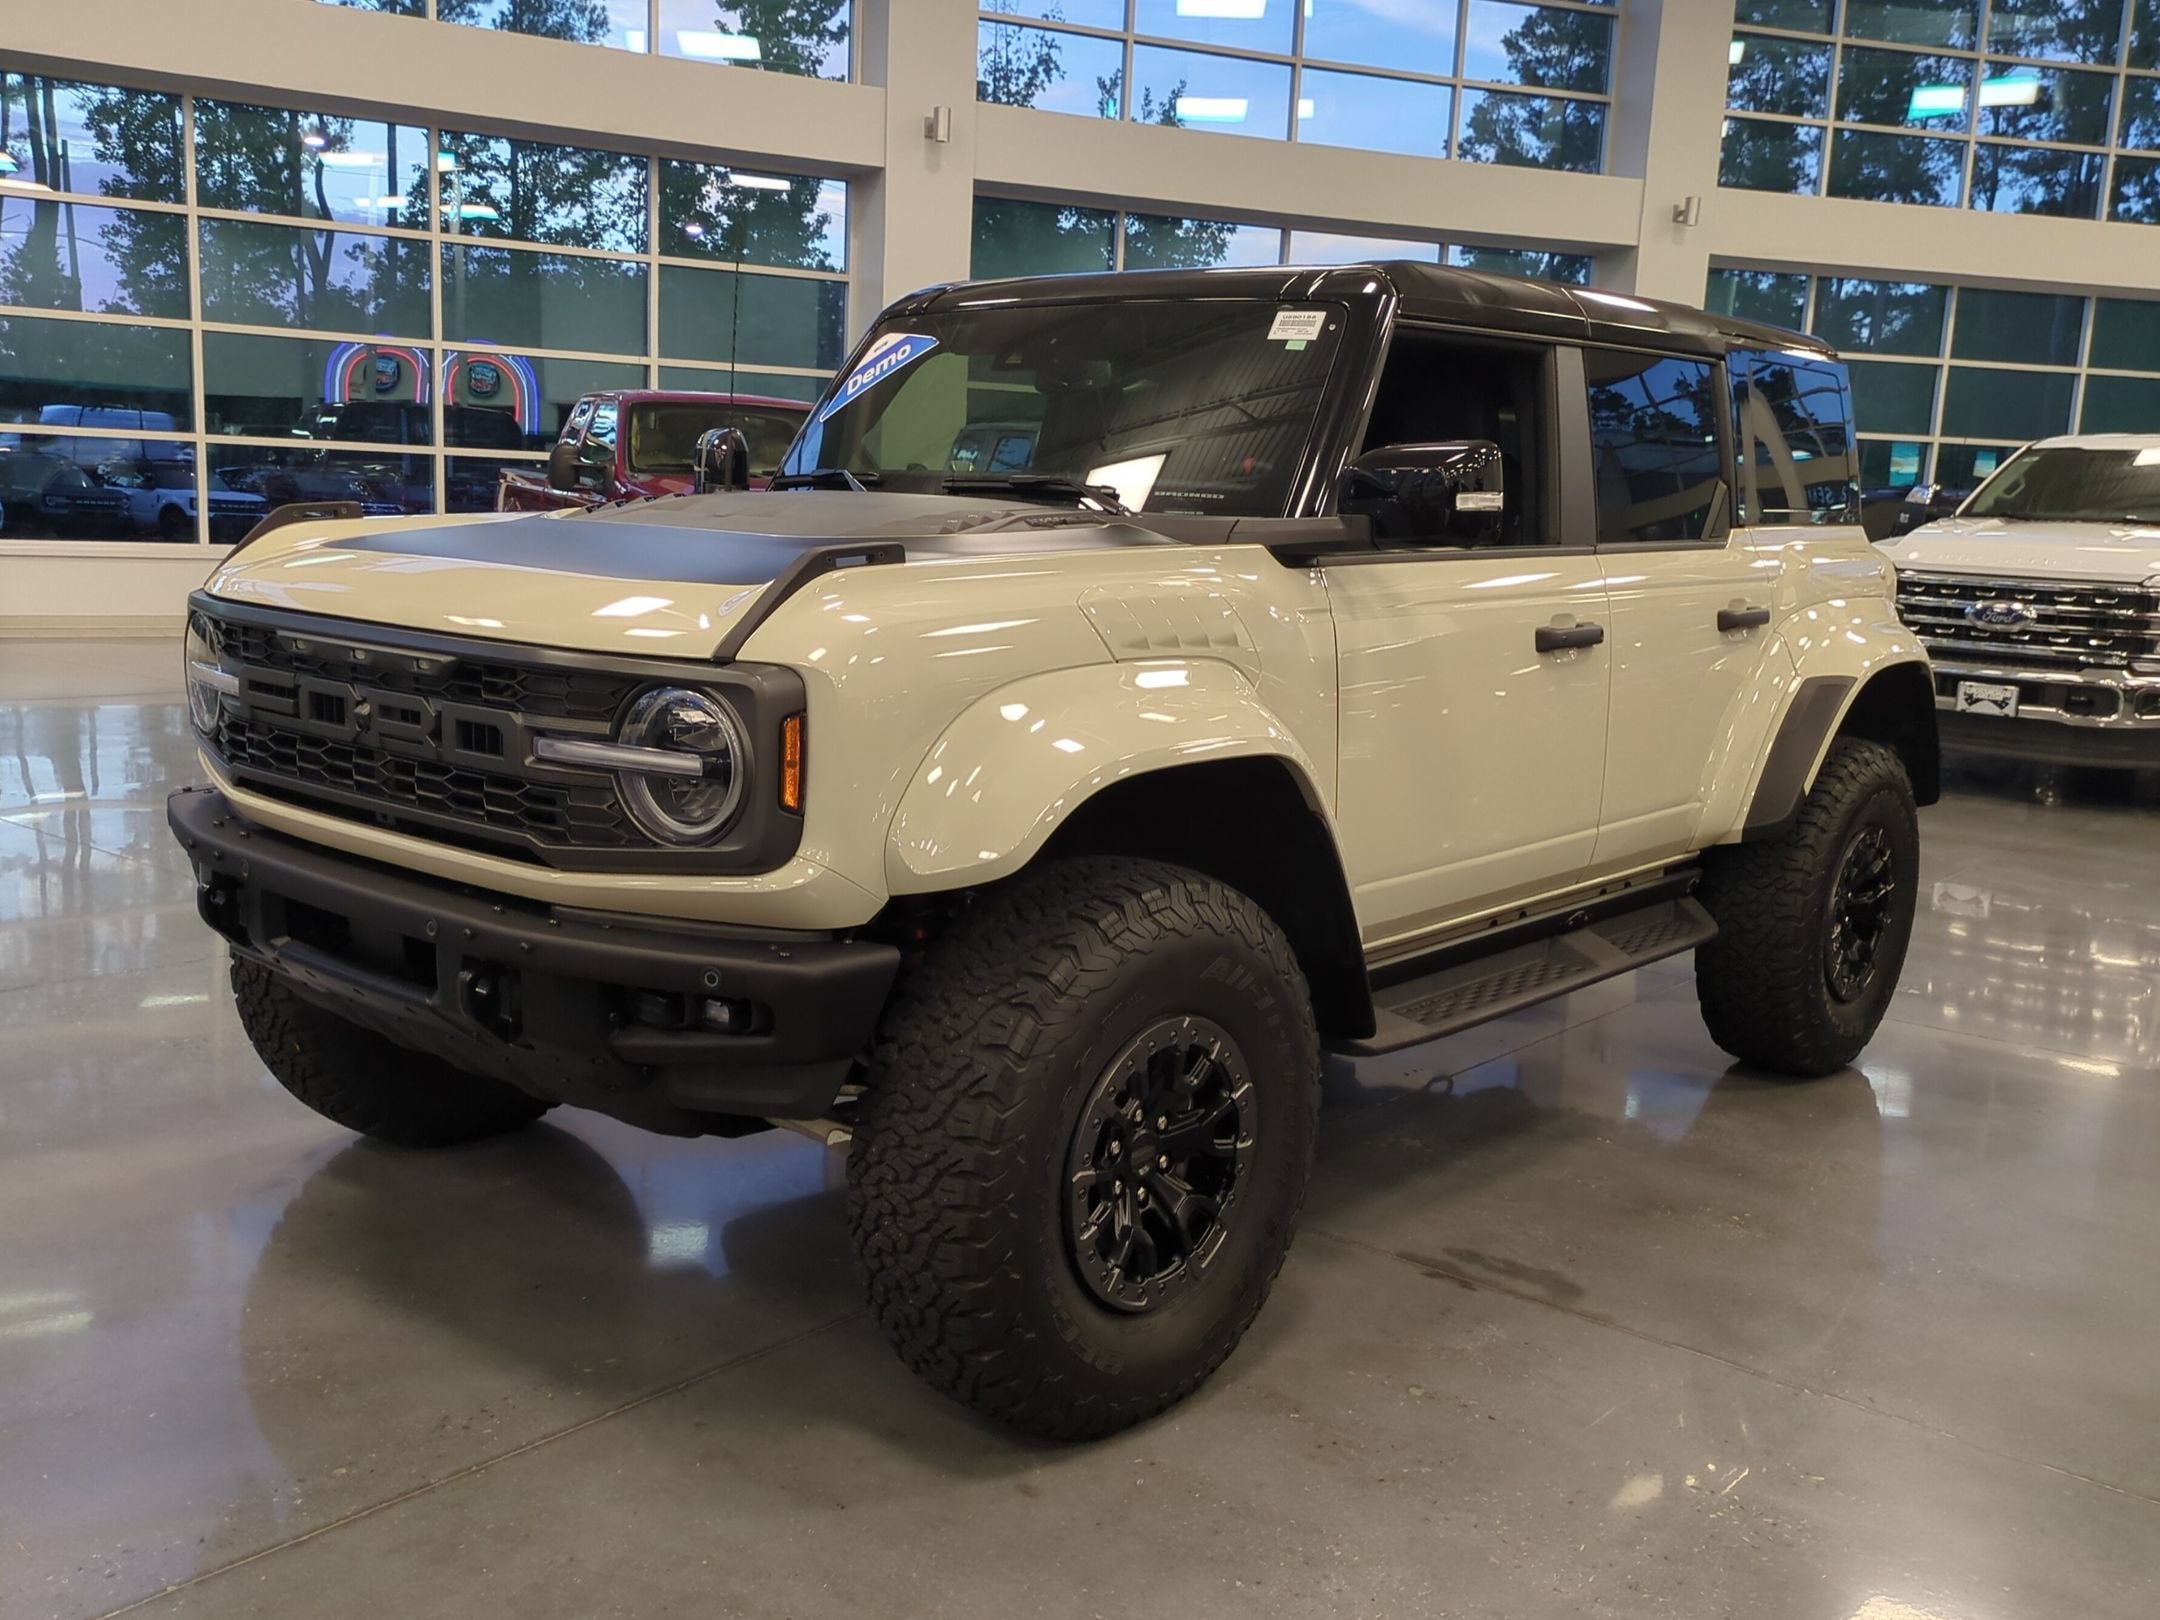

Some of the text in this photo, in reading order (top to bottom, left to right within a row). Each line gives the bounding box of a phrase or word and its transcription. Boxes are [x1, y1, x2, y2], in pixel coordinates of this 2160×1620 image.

[847, 344, 912, 395] Demo
[1981, 608, 2016, 624] Ford
[240, 664, 524, 776] FORD
